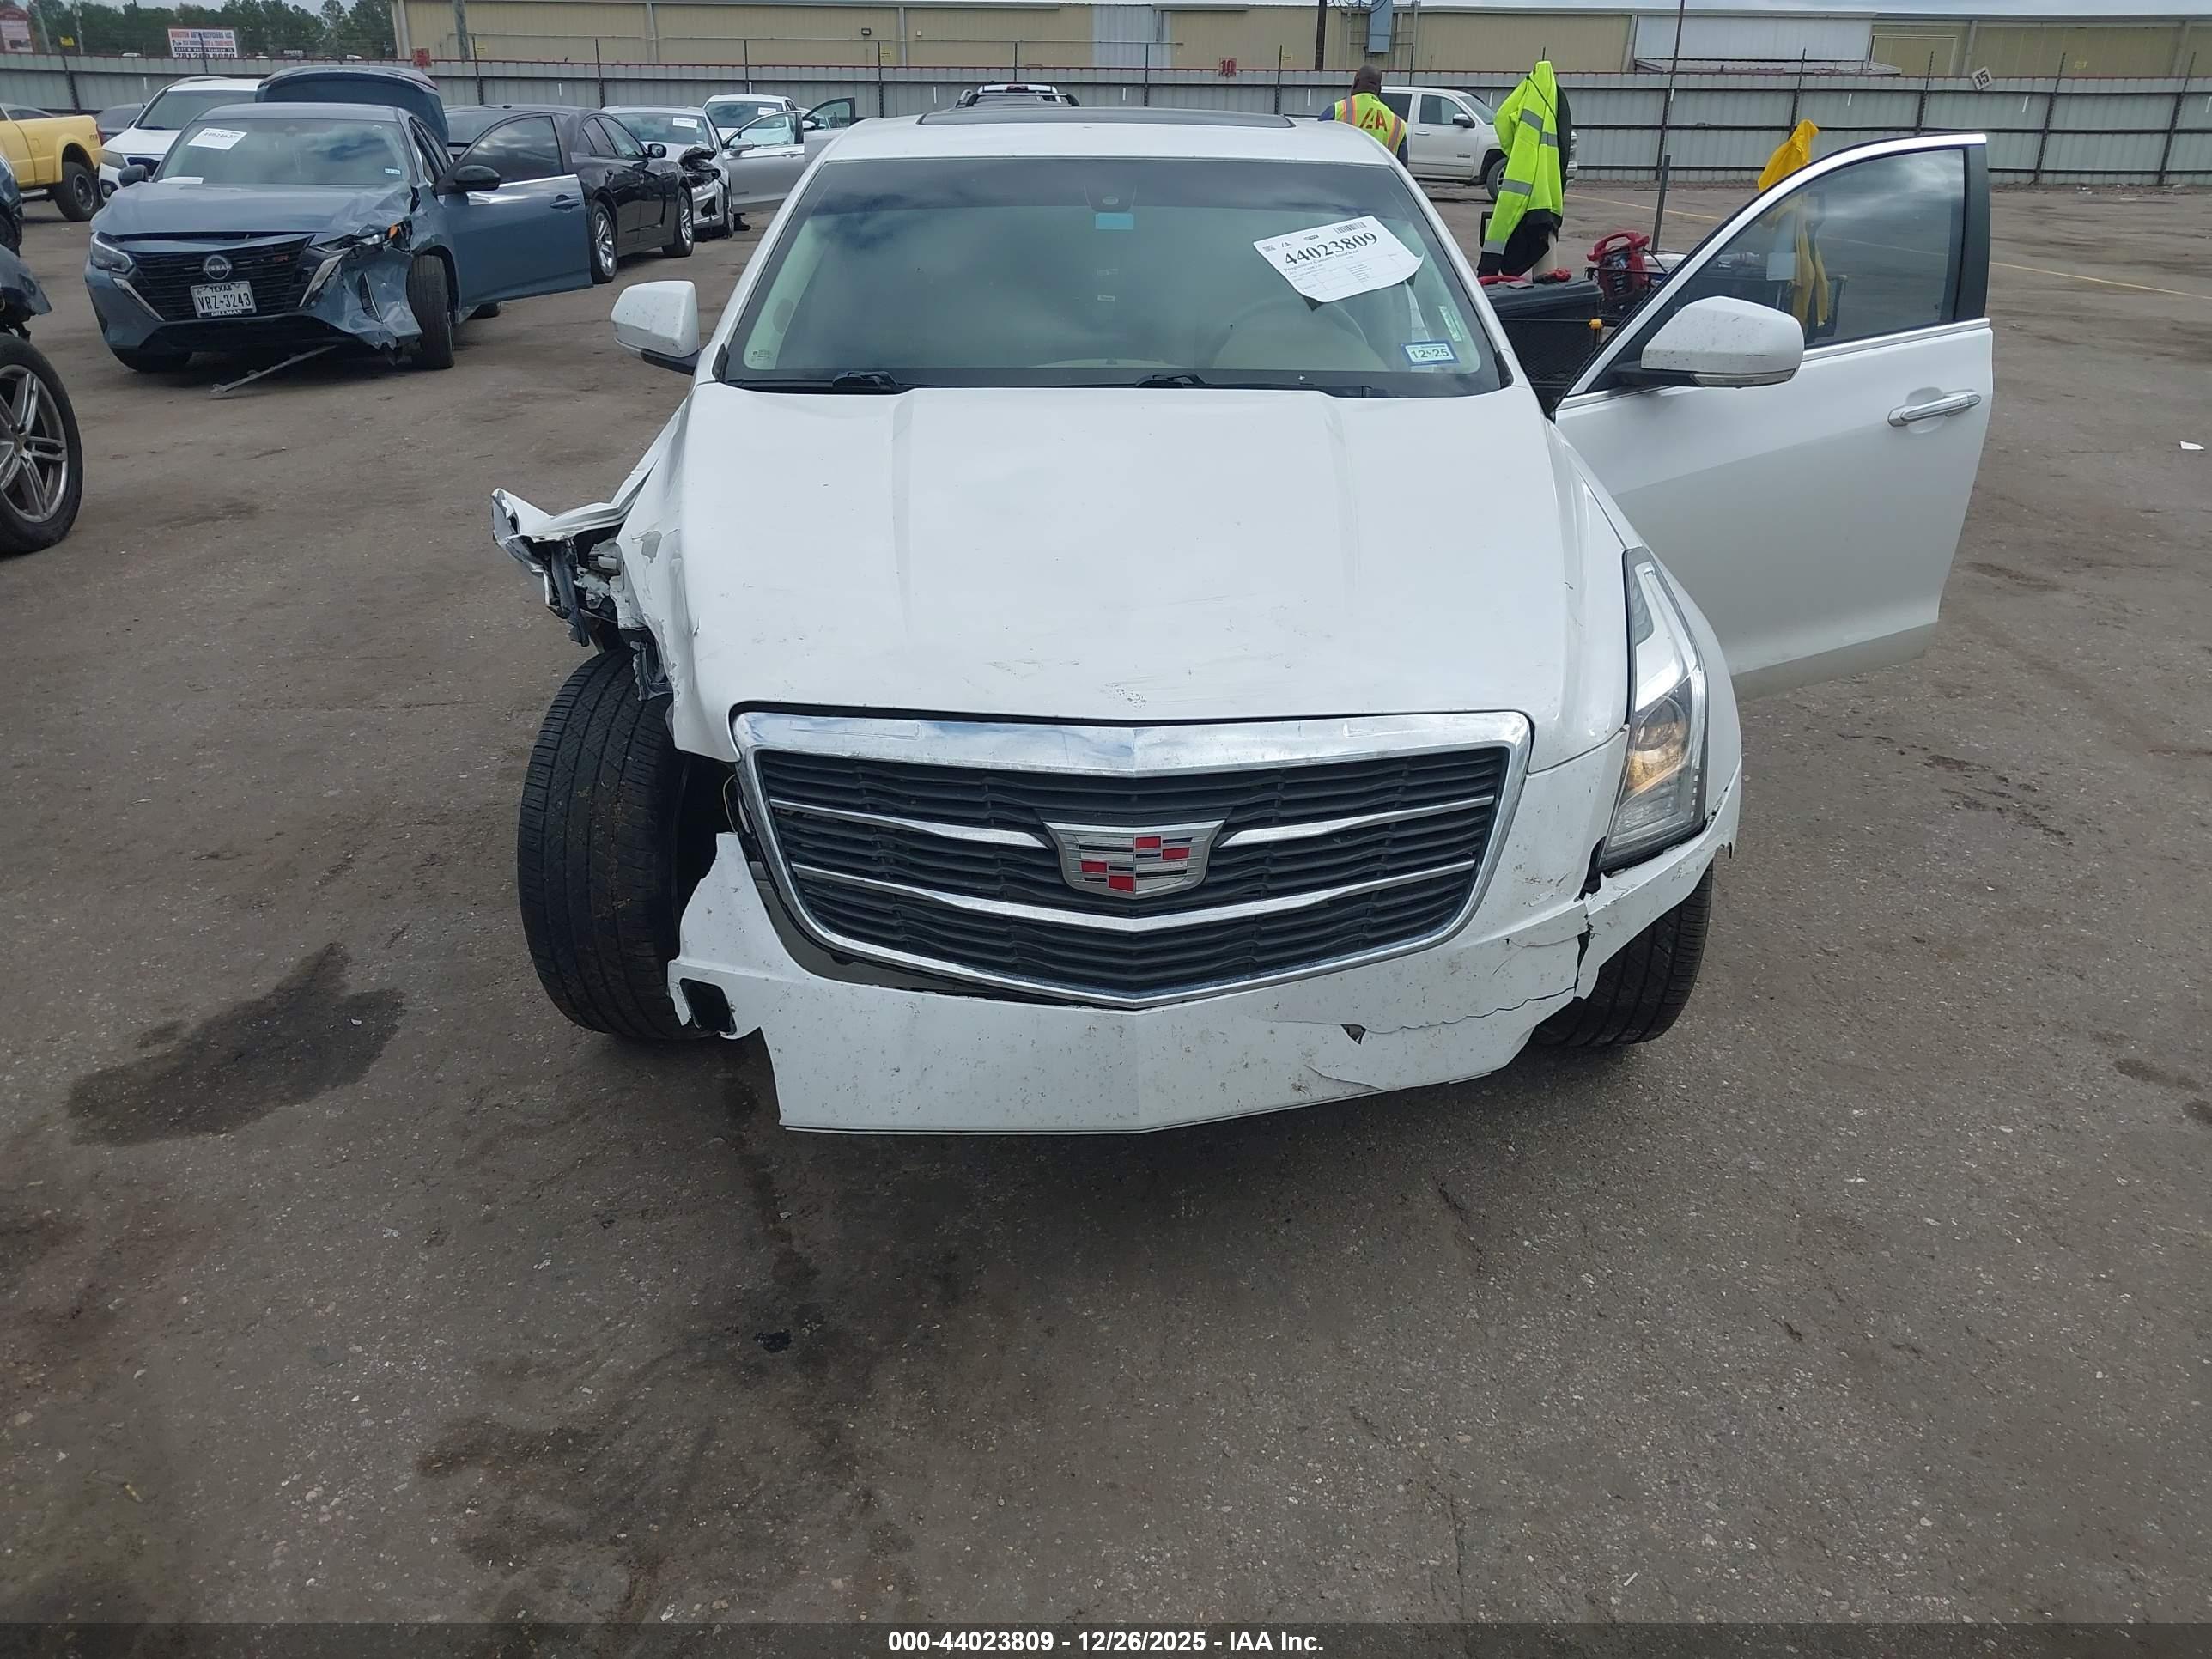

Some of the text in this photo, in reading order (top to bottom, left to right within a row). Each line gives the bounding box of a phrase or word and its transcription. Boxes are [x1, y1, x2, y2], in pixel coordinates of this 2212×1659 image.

[1975, 70, 1990, 85] 15
[1285, 231, 1378, 265] 44023809
[204, 264, 232, 272] NISSAN
[210, 283, 233, 293] TEXAS
